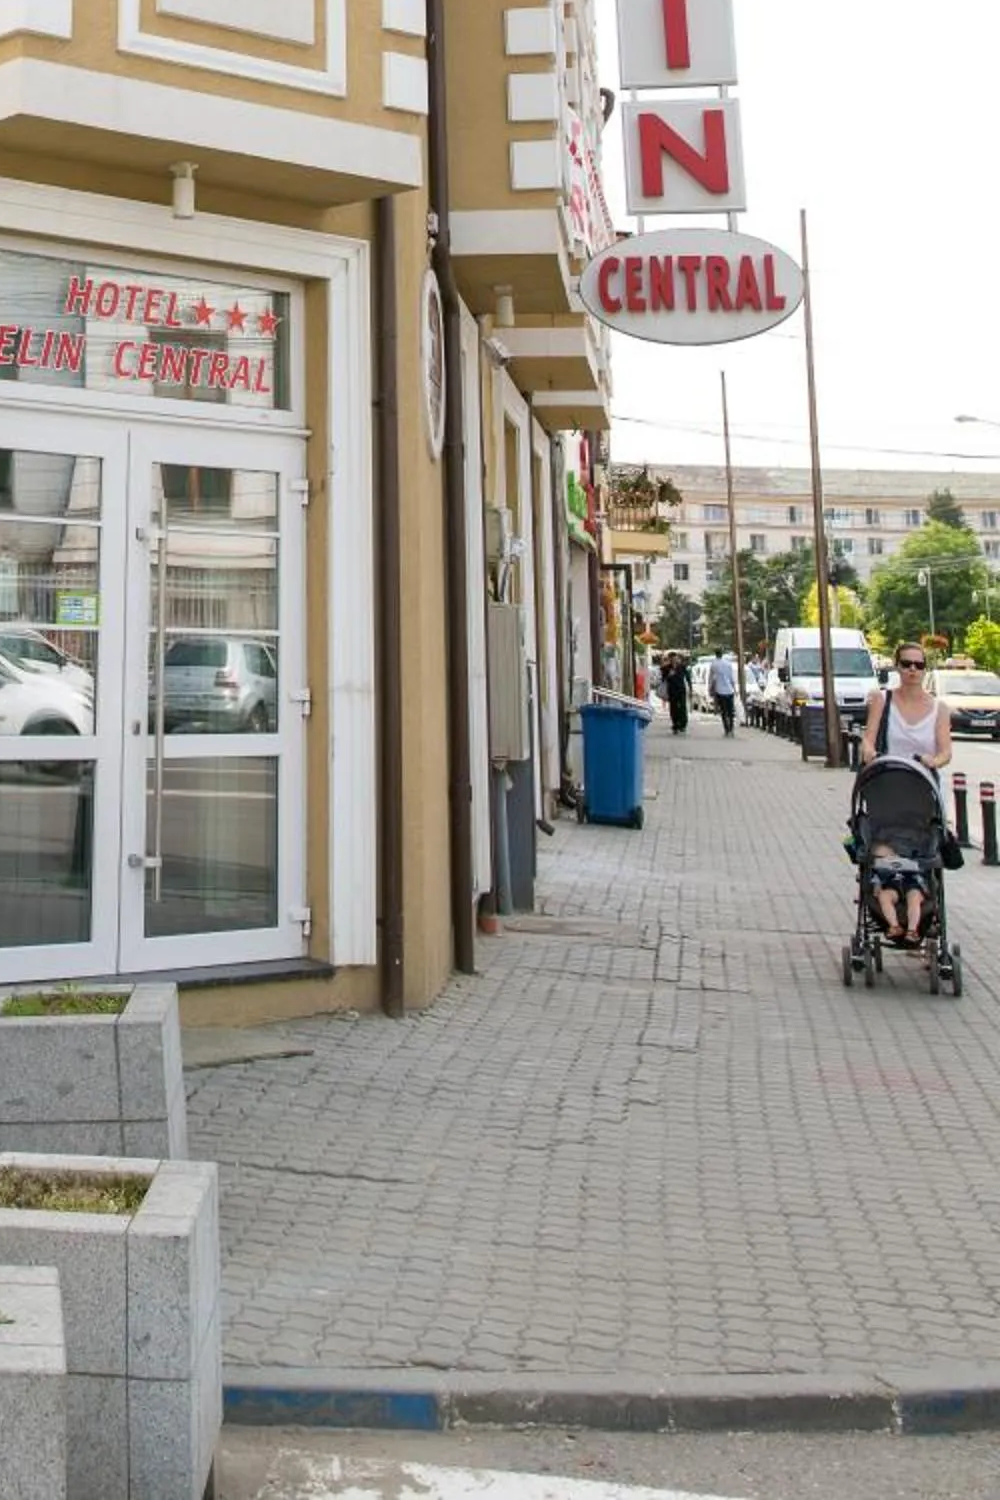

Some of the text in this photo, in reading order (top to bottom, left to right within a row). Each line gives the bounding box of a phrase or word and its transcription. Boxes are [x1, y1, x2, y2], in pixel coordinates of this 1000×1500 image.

[64, 275, 182, 328] HOTEL
[598, 253, 787, 314] CENTRAL
[112, 340, 271, 393] CENTRAL
